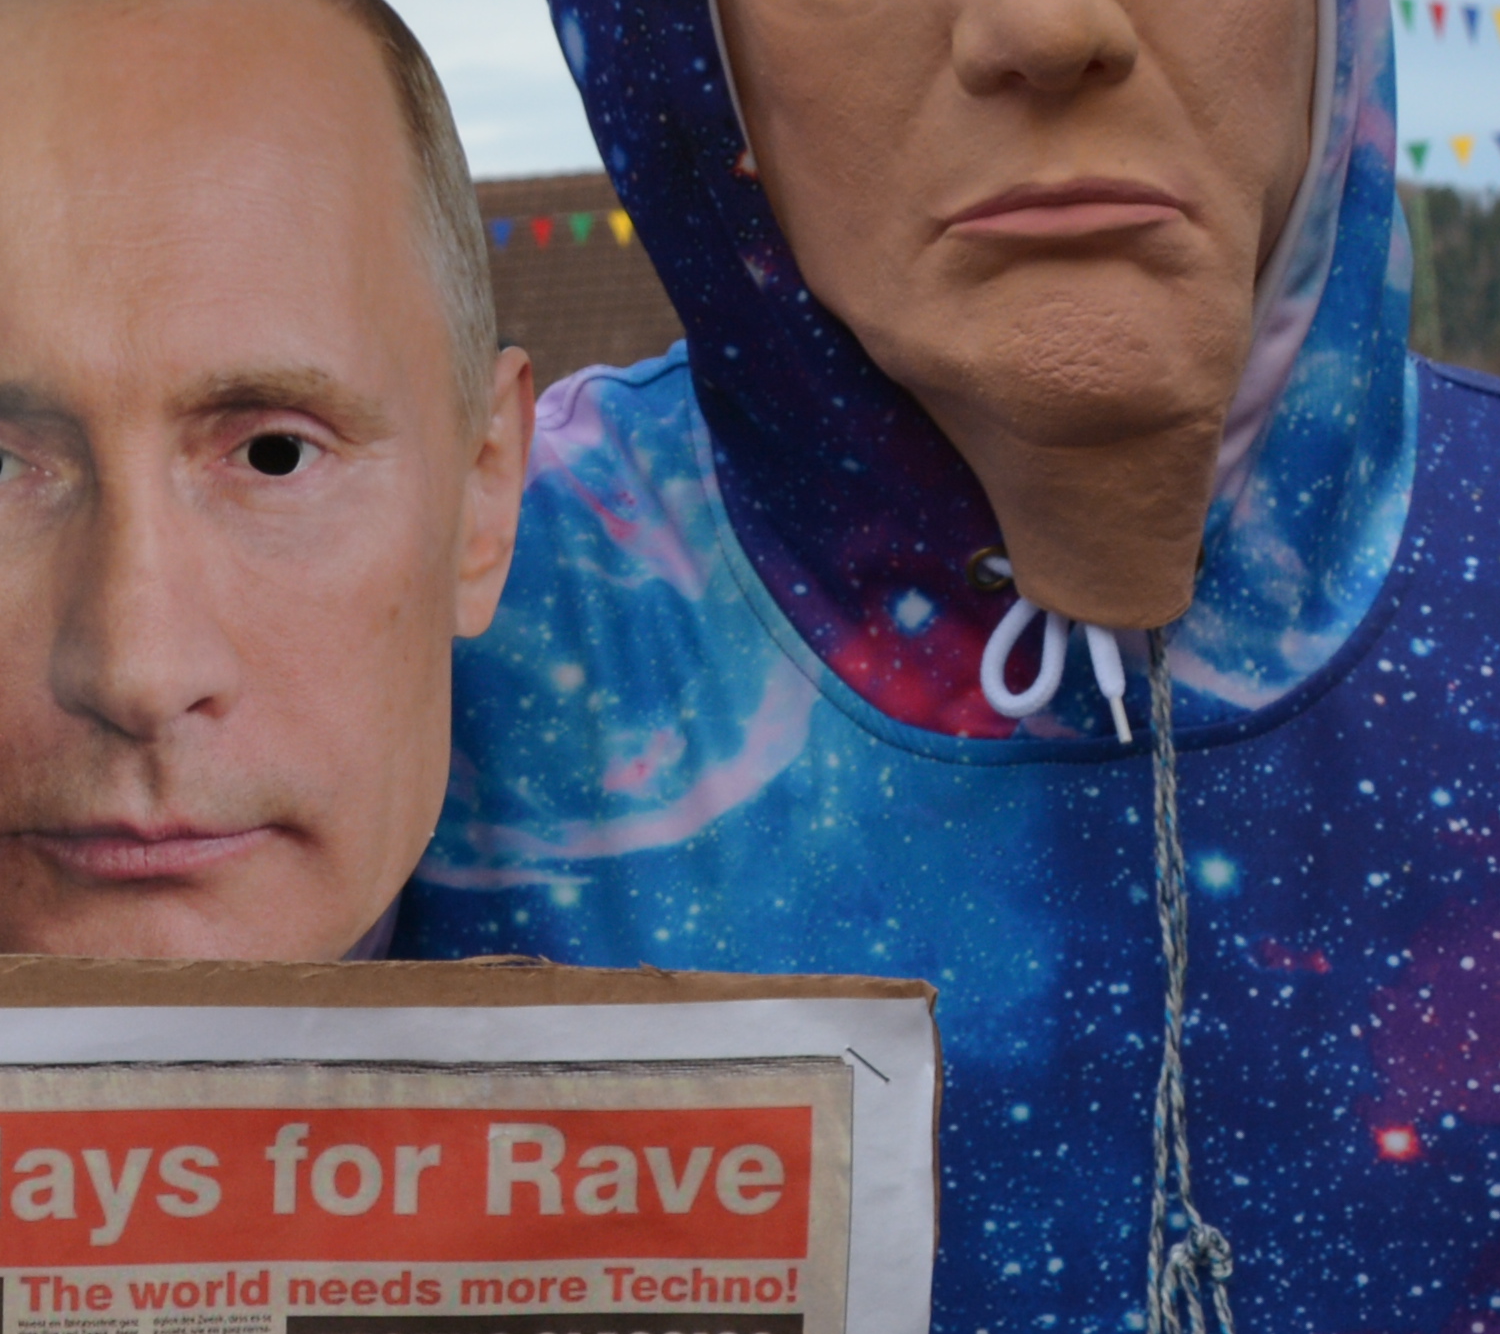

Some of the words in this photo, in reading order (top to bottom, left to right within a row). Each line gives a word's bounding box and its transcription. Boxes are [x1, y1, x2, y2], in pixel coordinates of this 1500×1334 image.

[266, 1124, 441, 1215] for
[487, 1123, 783, 1215] Rave
[23, 1276, 113, 1310] The
[130, 1271, 270, 1309] world
[288, 1271, 441, 1305] needs
[461, 1277, 586, 1304] more
[605, 1267, 798, 1303] Techno!
